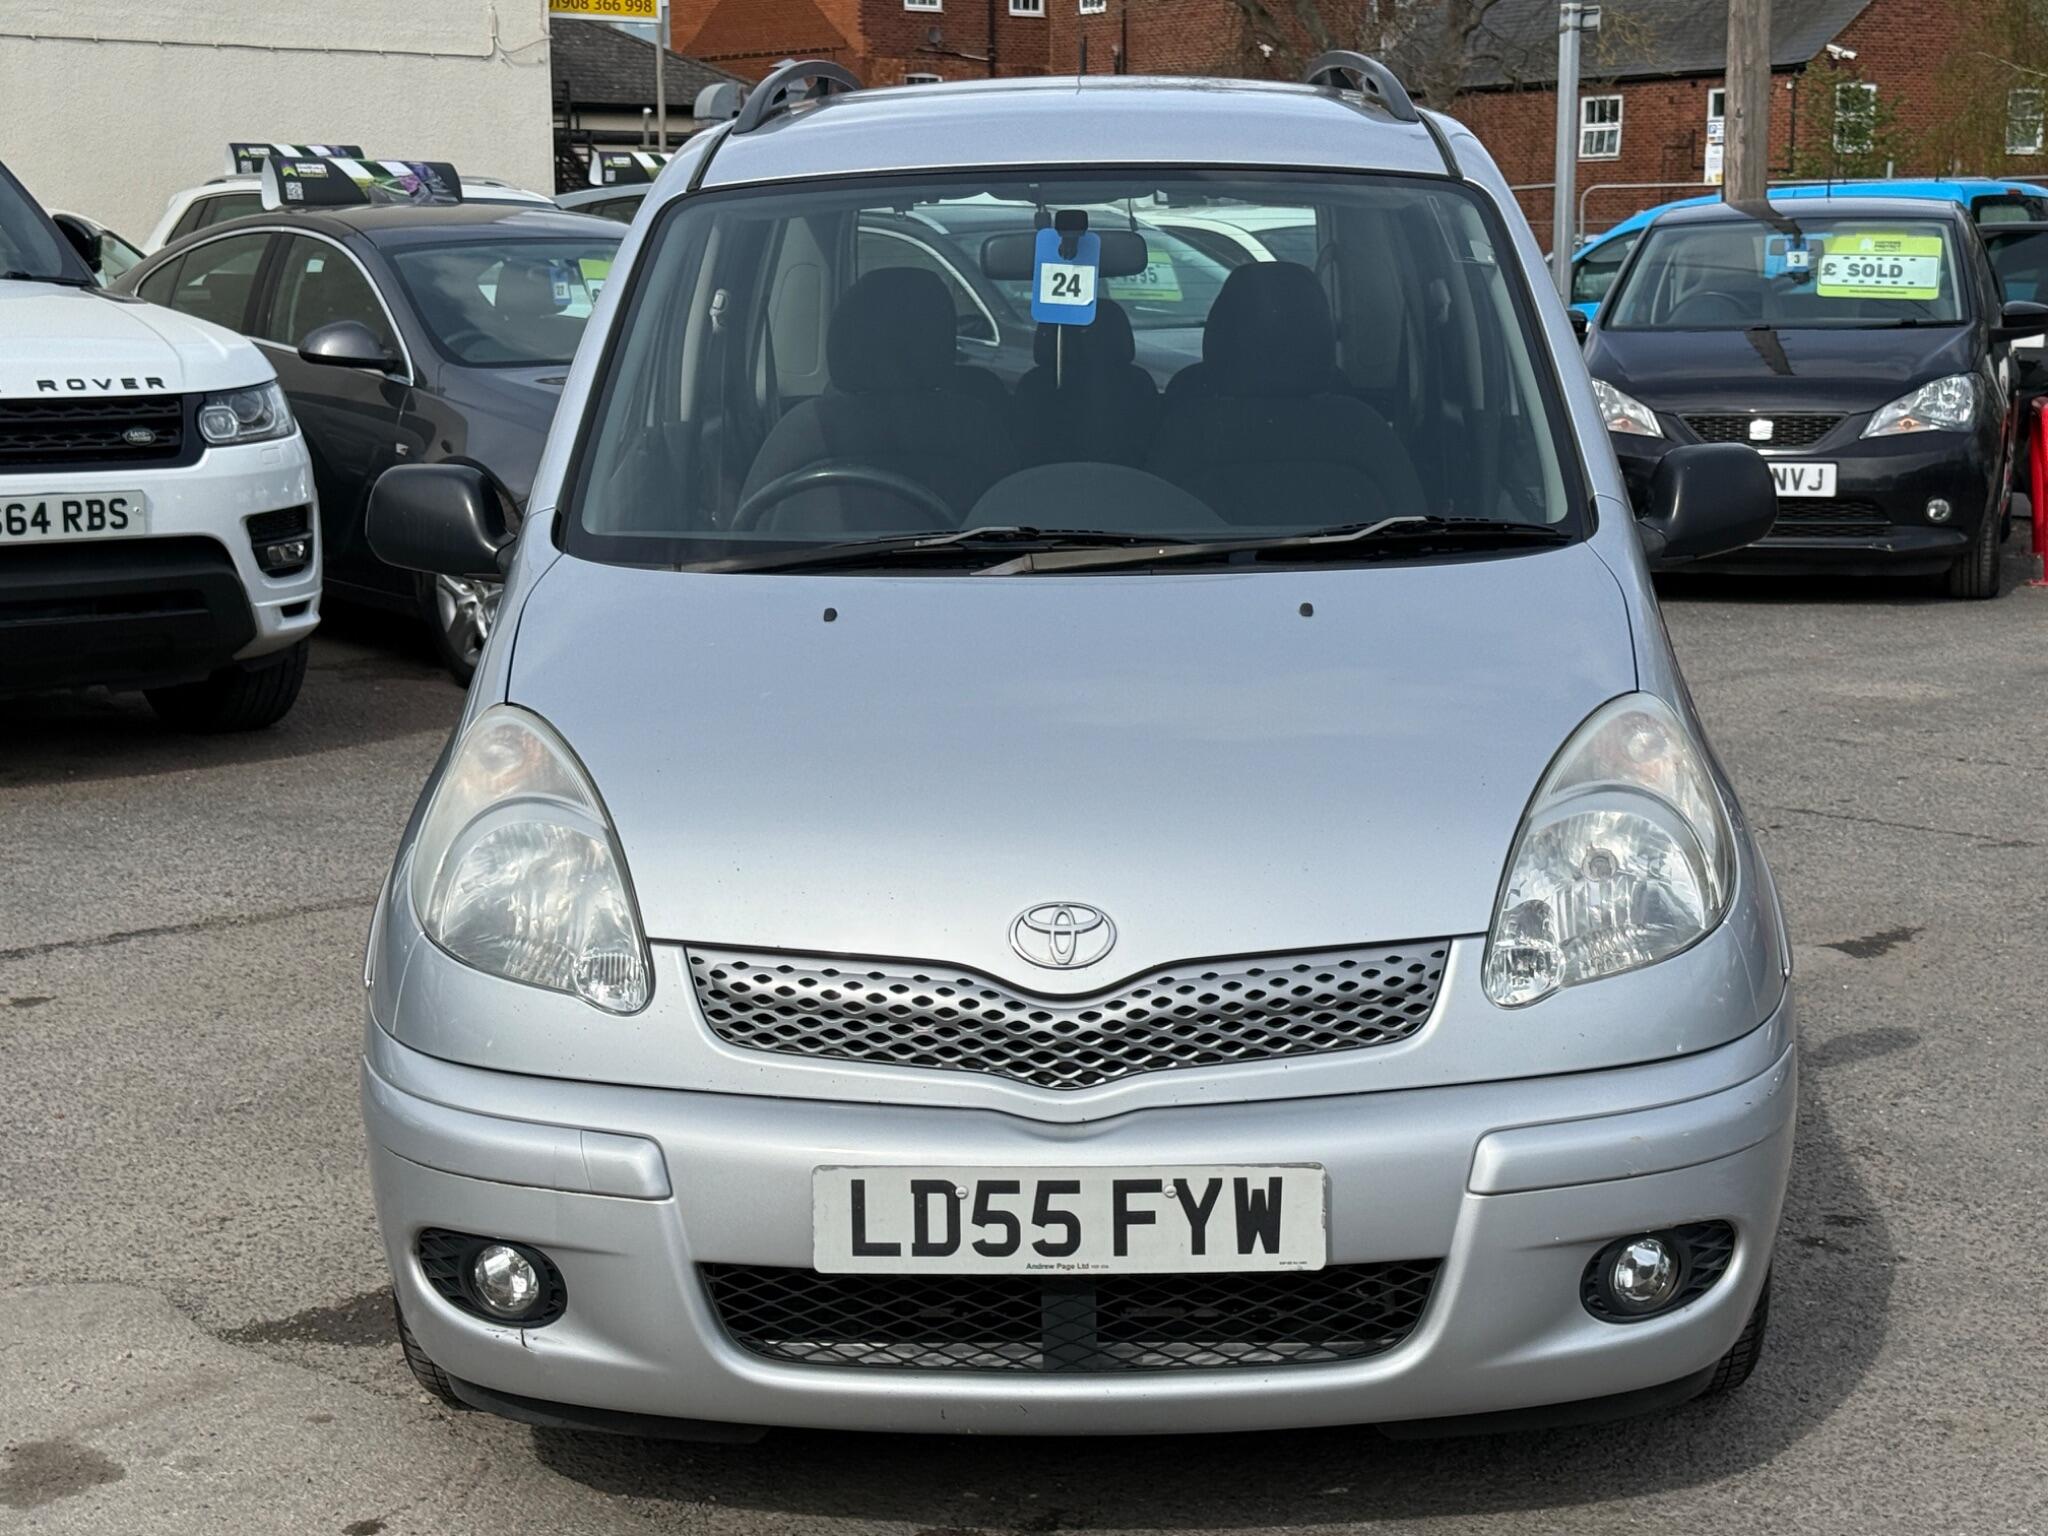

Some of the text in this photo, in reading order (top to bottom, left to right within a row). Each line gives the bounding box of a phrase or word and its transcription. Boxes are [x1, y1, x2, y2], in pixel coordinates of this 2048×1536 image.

[594, 0, 621, 11] 366
[625, 0, 653, 13] 998
[1793, 254, 1801, 264] 3
[1823, 262, 1904, 278] £ SOLD
[1051, 272, 1082, 298] 24
[36, 377, 166, 392] ROVER
[62, 498, 129, 533] RBS
[850, 1176, 1283, 1257] LD55 FYW
[1056, 1263, 1075, 1271] Page
